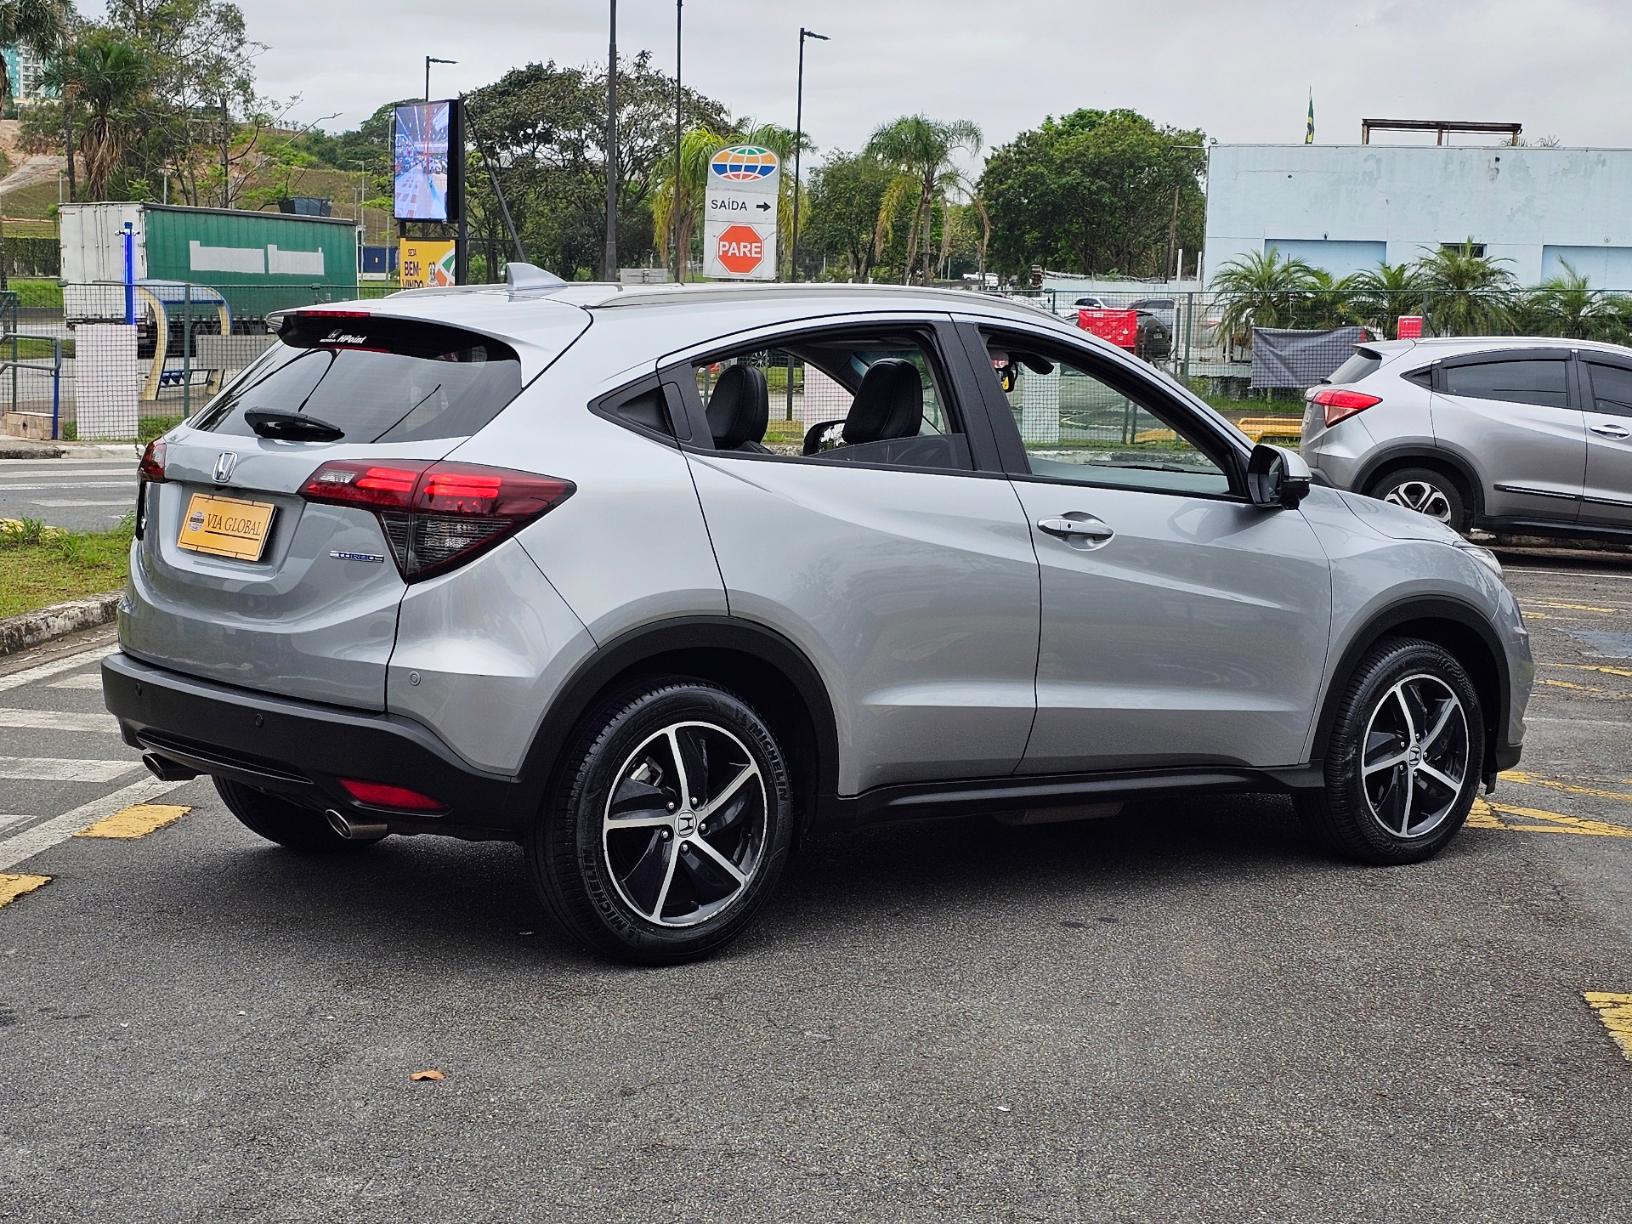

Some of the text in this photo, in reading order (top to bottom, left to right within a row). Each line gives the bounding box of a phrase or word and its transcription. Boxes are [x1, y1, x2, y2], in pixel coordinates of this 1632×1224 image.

[711, 197, 747, 211] SAÍDA
[719, 241, 761, 258] PARE
[404, 261, 421, 277] BEM-
[207, 513, 222, 530] VIA
[224, 516, 261, 536] GLOBAL
[338, 552, 376, 561] TURBO
[749, 720, 790, 801] MICHELIN
